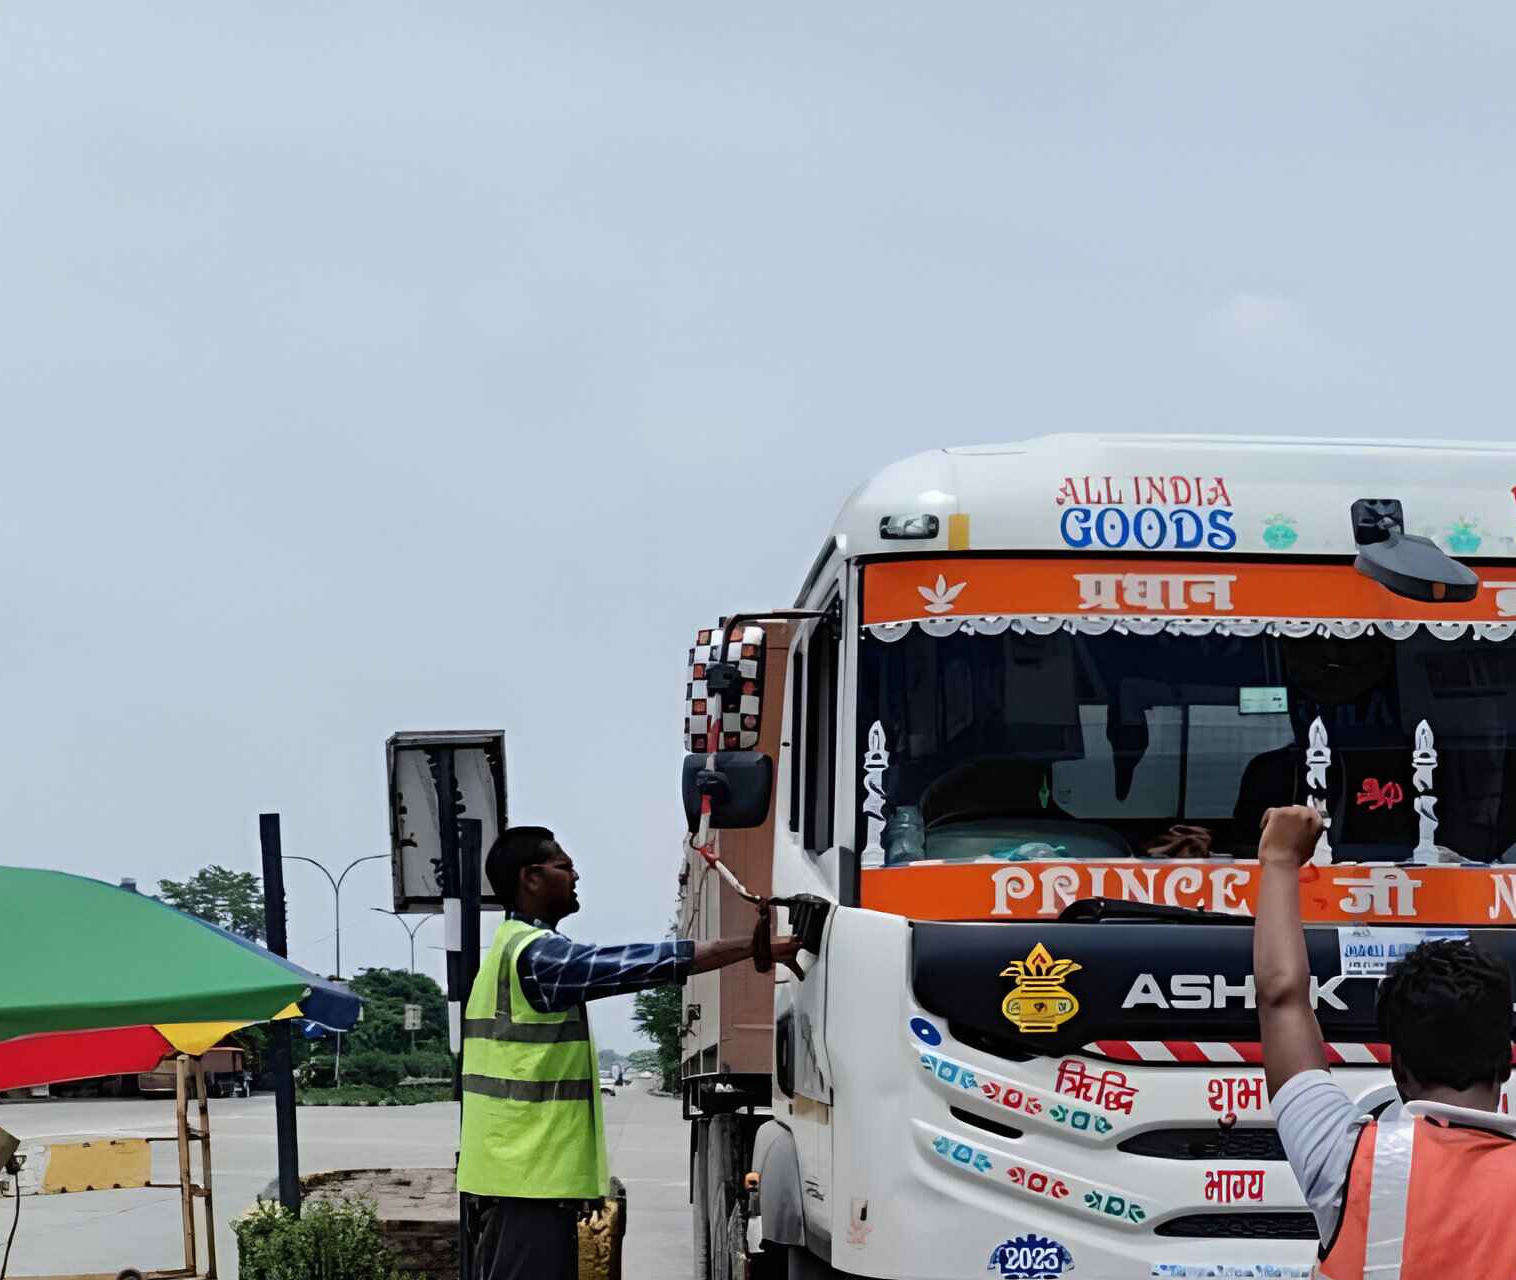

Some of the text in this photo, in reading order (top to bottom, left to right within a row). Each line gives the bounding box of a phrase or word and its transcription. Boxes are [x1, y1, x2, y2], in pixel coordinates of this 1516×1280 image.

[1056, 476, 1124, 506] ALL
[1132, 476, 1232, 507] INDIA
[1060, 507, 1237, 550] GOODS
[1073, 573, 1237, 611] प्रधान
[991, 867, 1252, 916] PRINCE
[1333, 868, 1422, 916] जी
[1122, 973, 1350, 1011] ASHK
[1205, 1170, 1265, 1202] भाग्य
